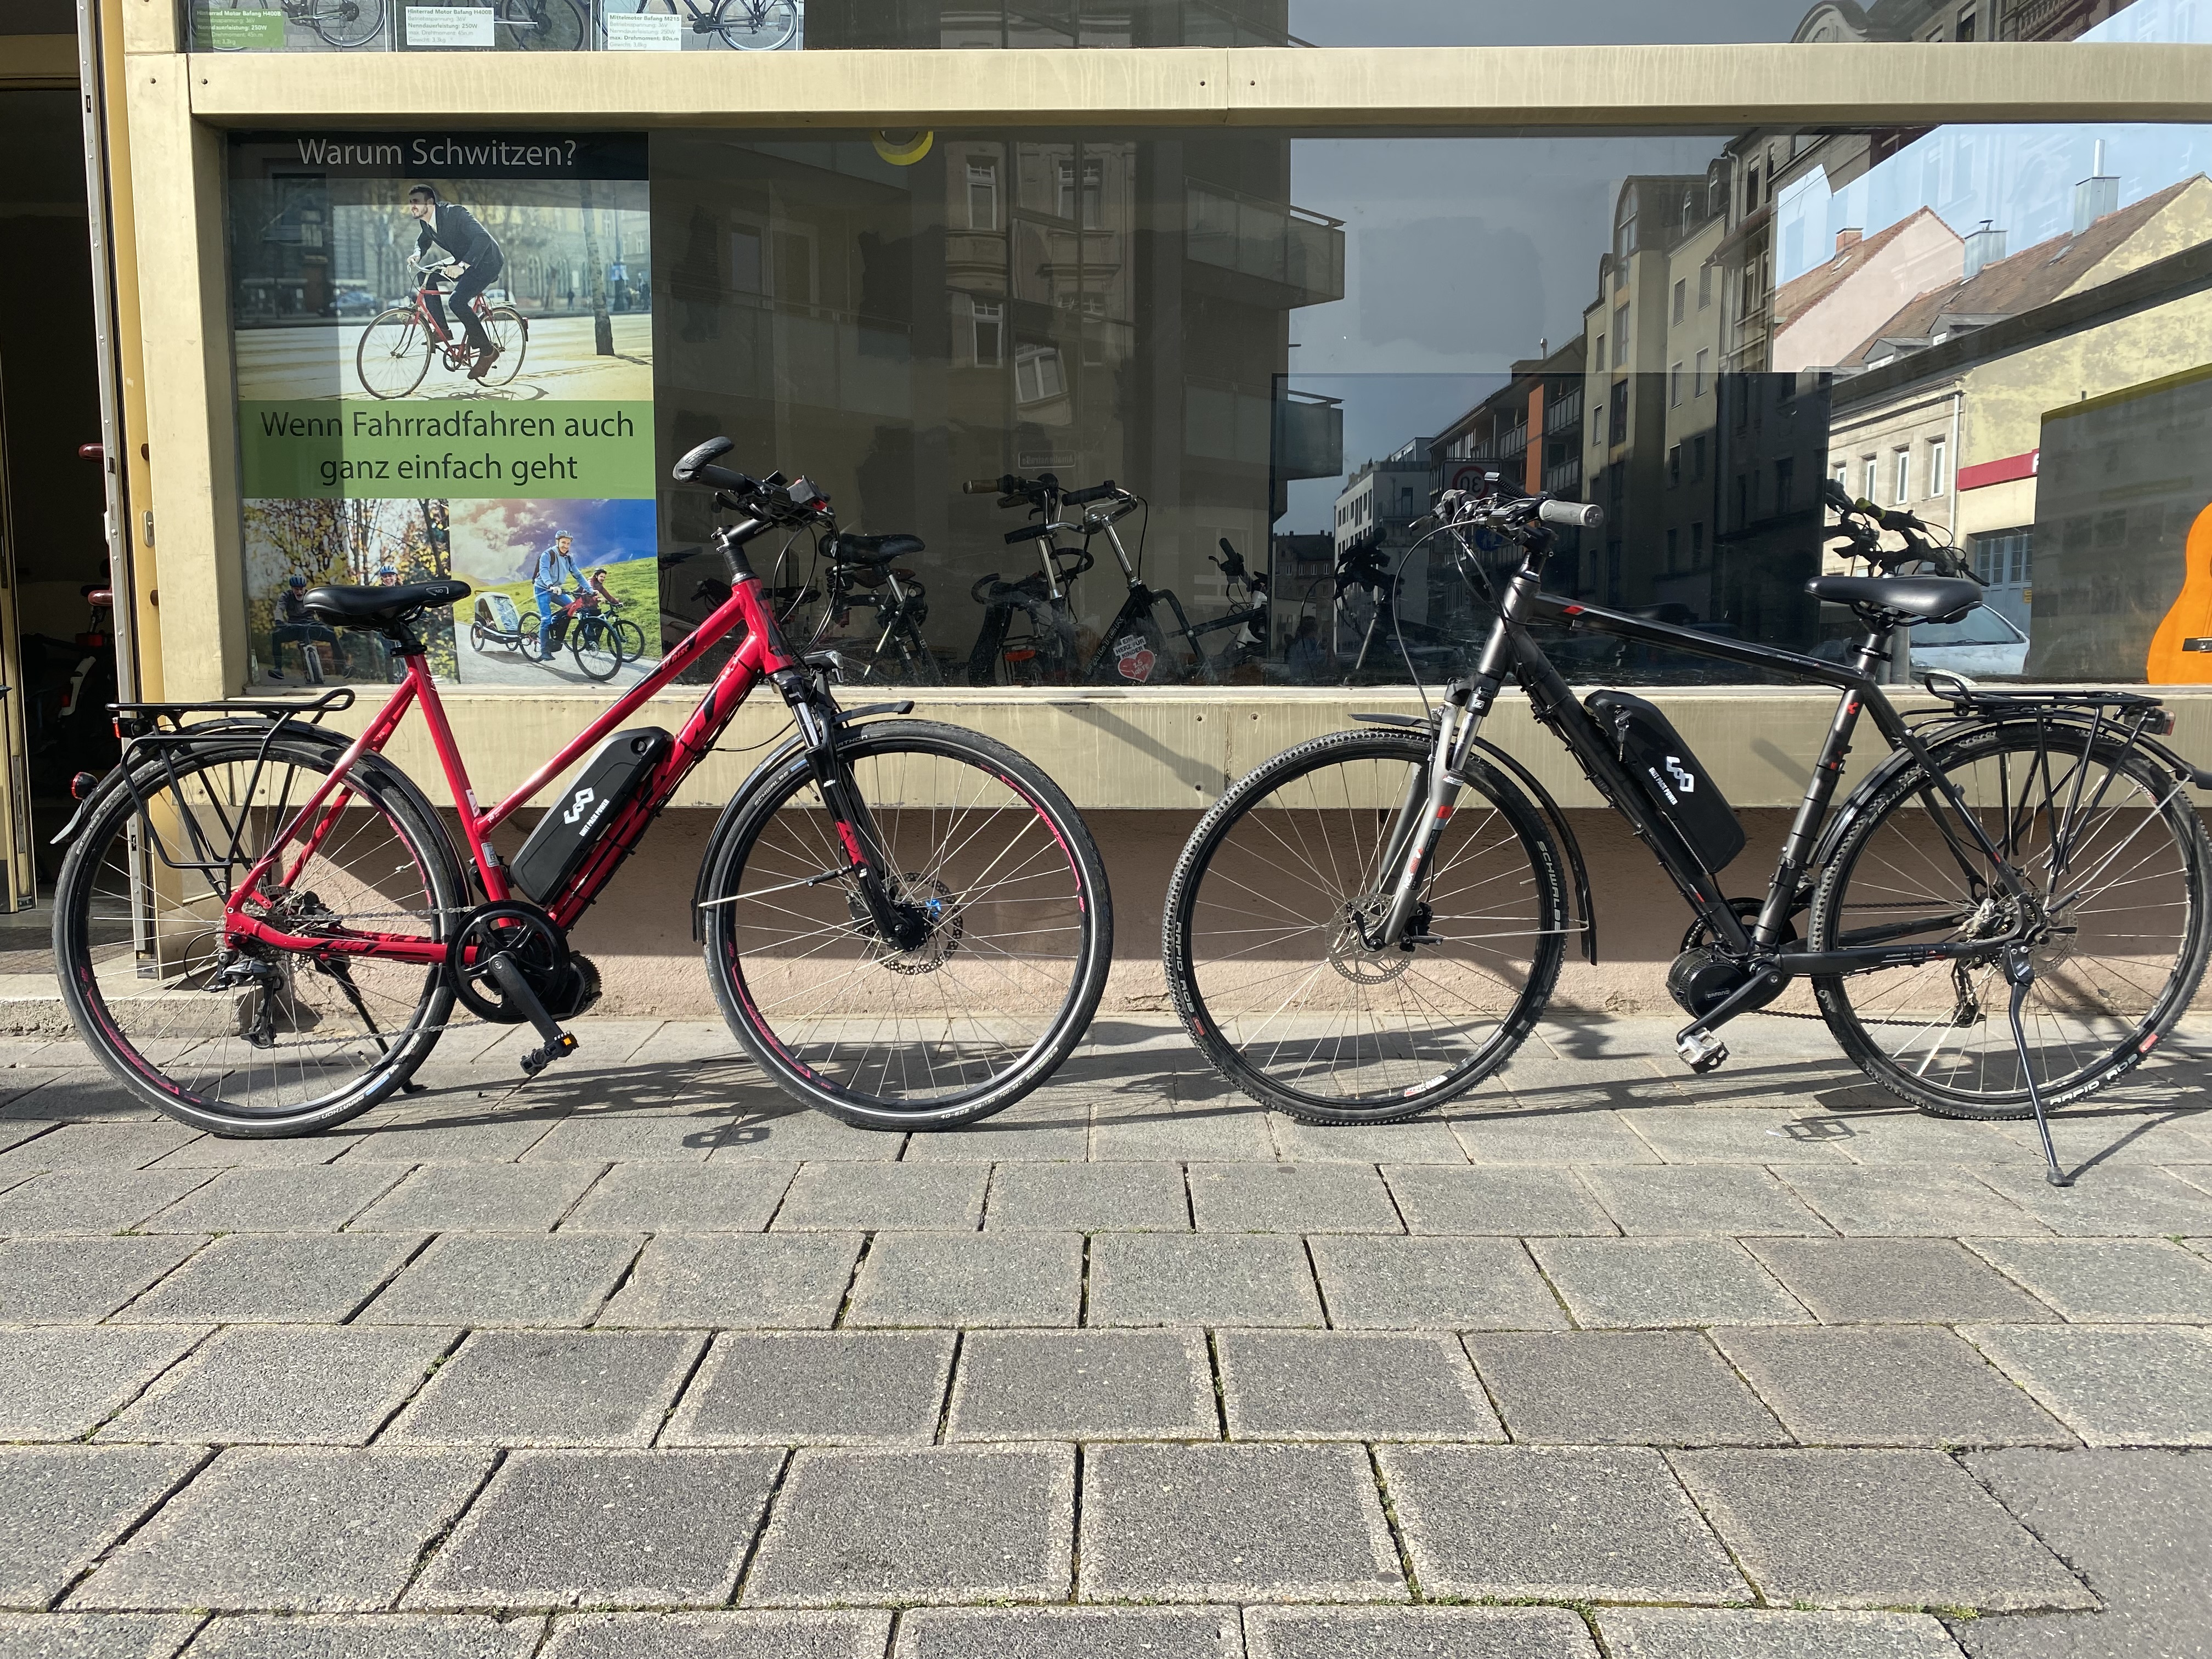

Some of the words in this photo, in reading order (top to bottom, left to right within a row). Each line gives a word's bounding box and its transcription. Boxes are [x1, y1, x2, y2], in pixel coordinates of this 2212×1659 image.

[298, 139, 402, 165] Warum
[411, 138, 577, 166] Schwitzen?
[261, 411, 343, 437] Wenn
[353, 410, 555, 437] Fahrradfahren
[565, 411, 635, 437] auch
[320, 458, 390, 485] ganz
[398, 454, 503, 479] einfach
[511, 455, 578, 485] geht
[1084, 616, 1124, 675] FALTER
[1116, 645, 1132, 654] HERZ
[1122, 646, 1143, 658] KINDER
[754, 771, 789, 807] SCHWALBE
[1649, 767, 1660, 779] UNIT
[1656, 777, 1668, 791] PACK
[1663, 788, 1678, 805] POWER
[579, 824, 590, 837] UNIT
[586, 813, 599, 827] PACK
[595, 798, 610, 816] POWER
[1537, 840, 1561, 931] SCHWALBE
[1180, 980, 1195, 1013] ROB
[1707, 990, 1730, 998] BAFANG
[2050, 1080, 2100, 1105] RAPID
[2106, 1053, 2138, 1080] ROB
[321, 1094, 364, 1119] MARATHON
[940, 1108, 970, 1119] 40-622
[999, 1081, 1023, 1098] 700x38C
